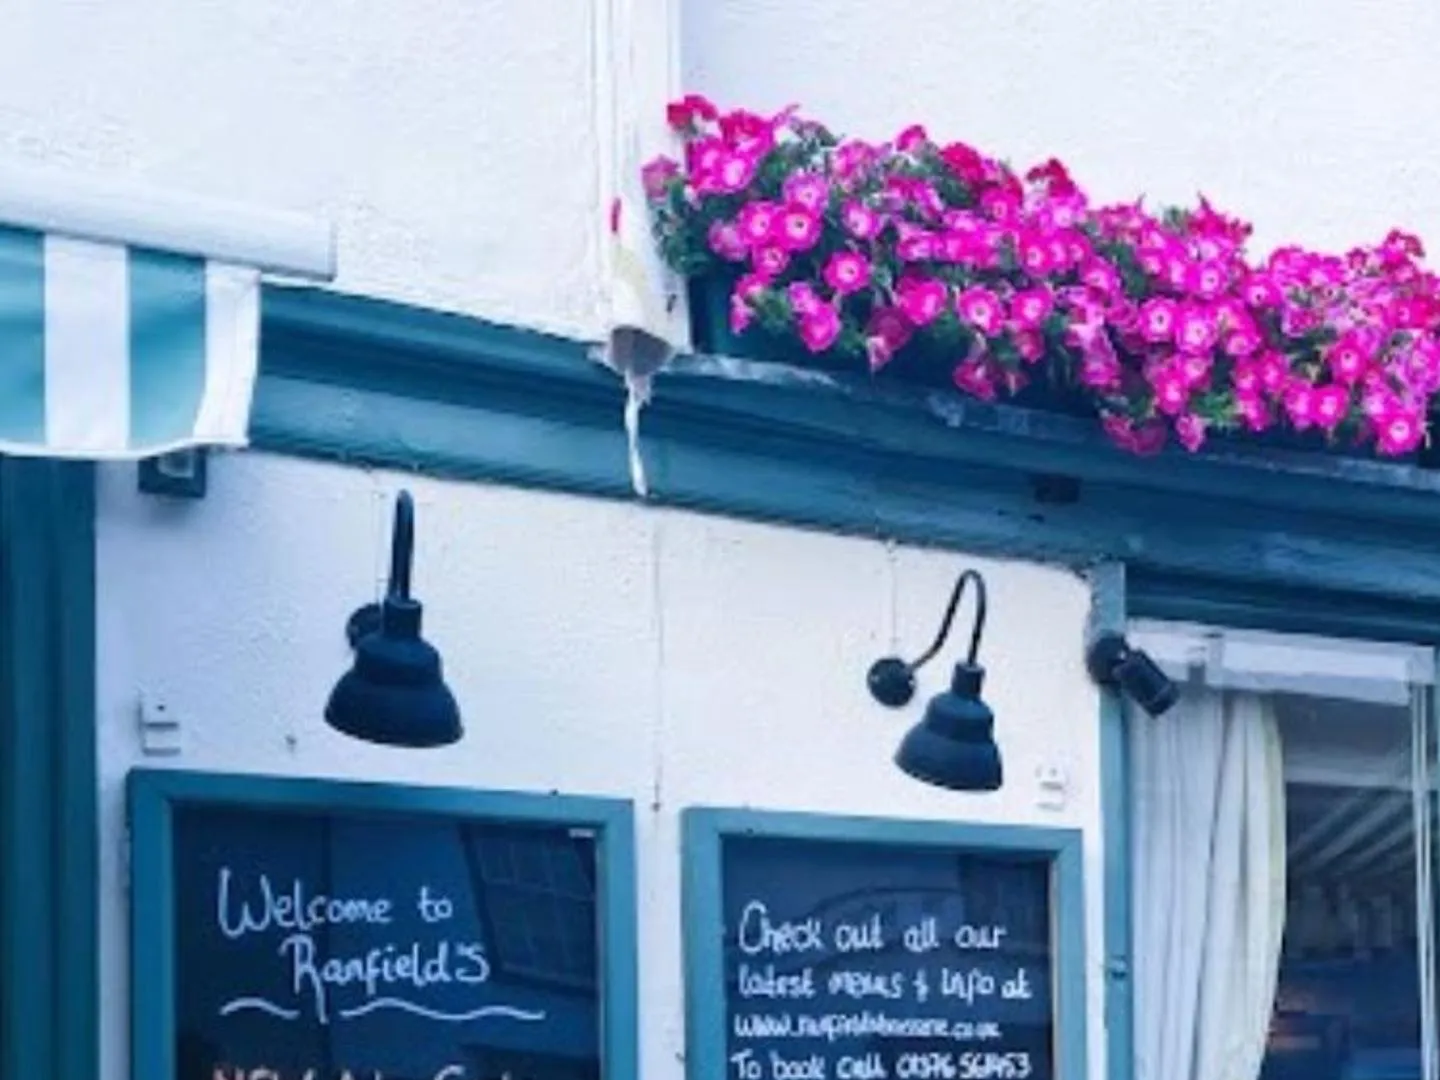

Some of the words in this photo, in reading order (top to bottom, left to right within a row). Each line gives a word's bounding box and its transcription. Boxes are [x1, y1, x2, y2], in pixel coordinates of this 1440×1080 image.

[217, 867, 393, 939] Welcome
[417, 886, 454, 923] to
[738, 900, 827, 953] Check
[834, 912, 886, 951] out
[902, 916, 942, 952] all
[953, 923, 1008, 949] our
[1000, 967, 1034, 1000] at
[729, 1048, 763, 1080] To
[769, 1049, 827, 1080] book
